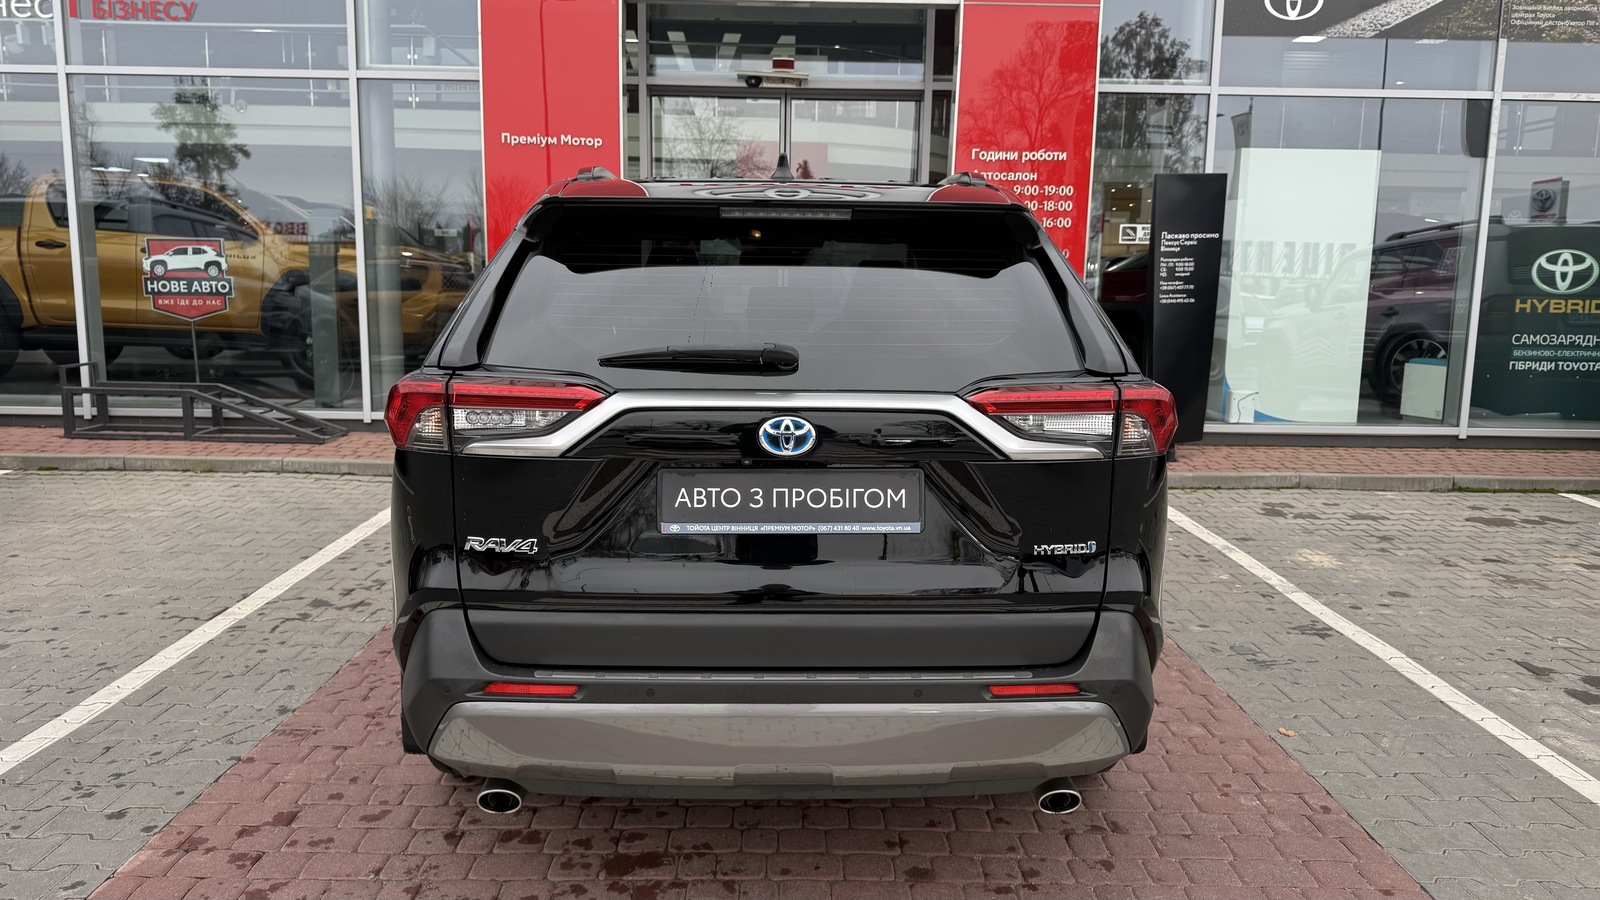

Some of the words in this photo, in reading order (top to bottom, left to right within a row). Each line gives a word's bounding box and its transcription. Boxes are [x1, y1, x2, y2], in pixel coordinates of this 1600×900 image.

[92, 0, 196, 20] БІЗНЕСУ
[501, 132, 557, 147] Преміум
[560, 134, 603, 148] Мотор
[971, 148, 1018, 162] Години
[1021, 148, 1067, 163] роботи
[973, 169, 1037, 181] втосалон
[1190, 232, 1220, 240] просимо
[147, 281, 188, 292] НОВЕ
[191, 281, 230, 293] АВТО
[177, 298, 190, 306] ЇДЕ
[1509, 361, 1555, 372] ГІБРИДИ
[1557, 361, 1600, 371] TOYOTA
[674, 487, 741, 508] АВТО
[749, 487, 764, 508] З
[773, 487, 906, 508] ПРОБІГОМ
[686, 524, 711, 532] ТОЙОТА
[464, 536, 538, 554] RAV4
[1033, 543, 1087, 555] HYBRID
